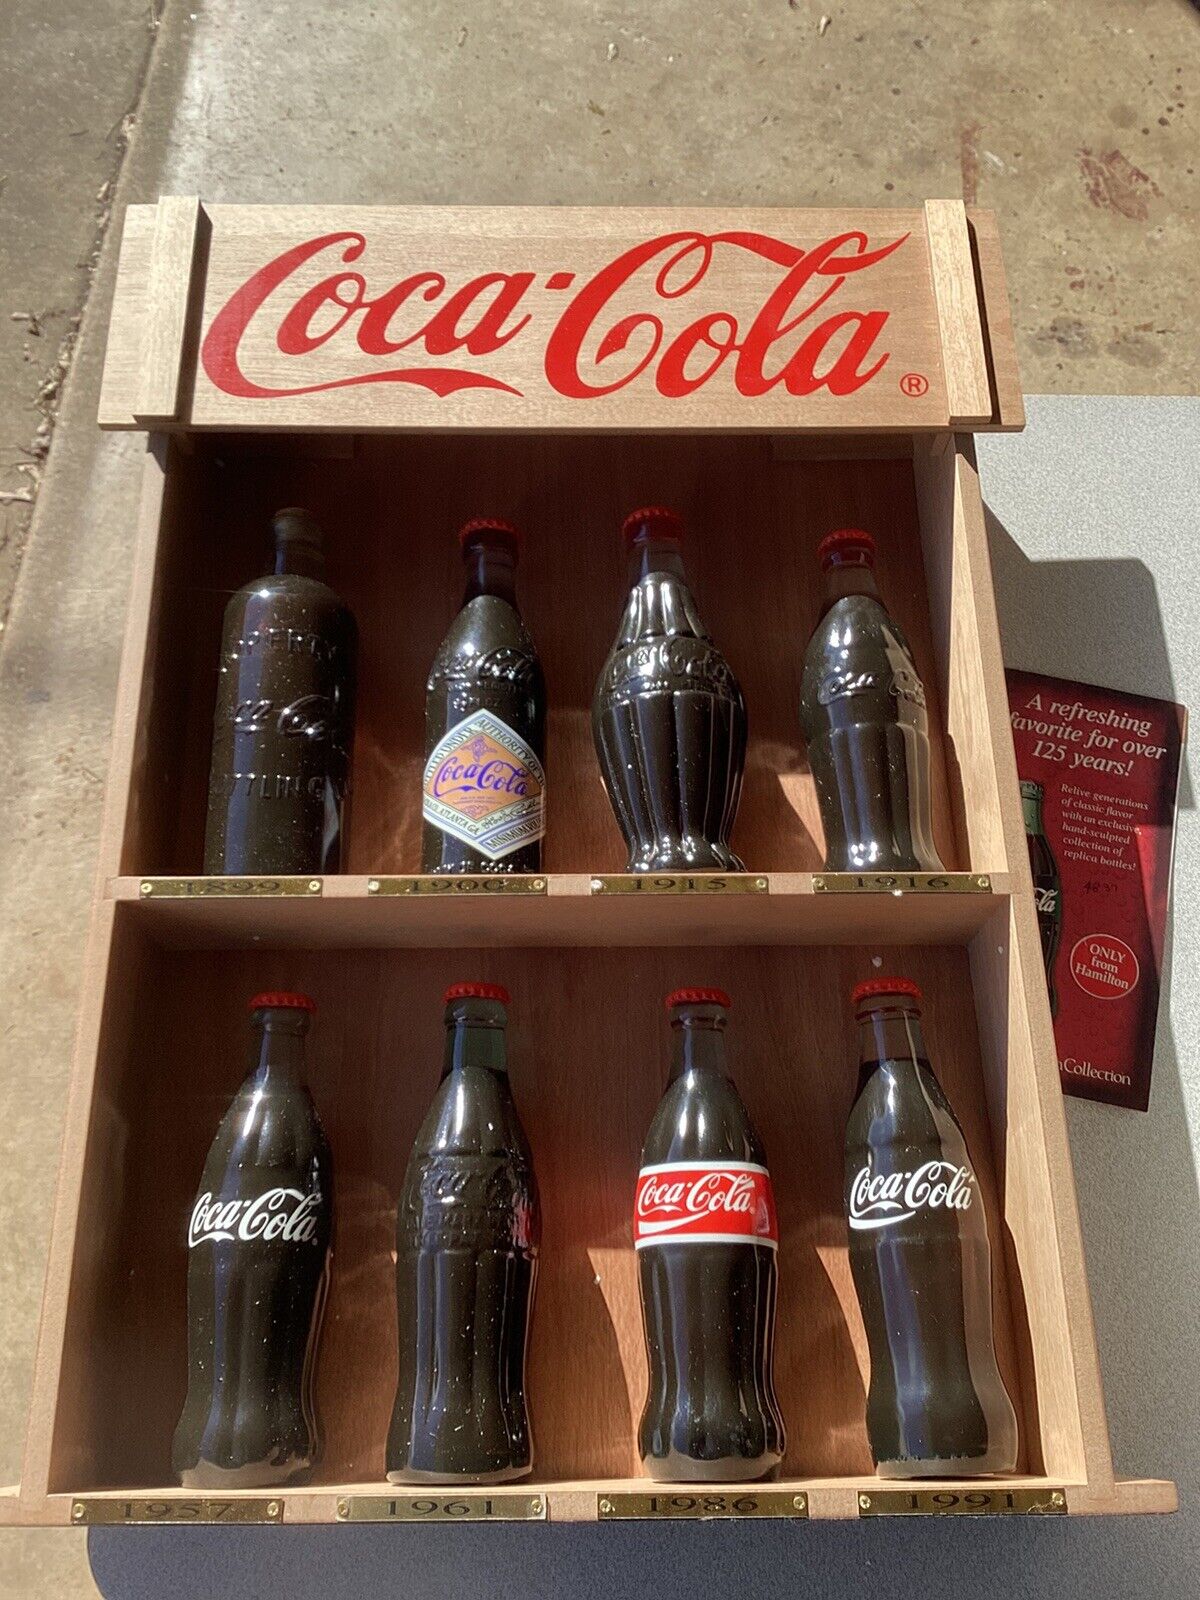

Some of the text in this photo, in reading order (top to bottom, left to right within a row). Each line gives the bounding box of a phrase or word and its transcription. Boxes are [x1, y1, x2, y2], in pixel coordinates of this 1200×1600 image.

[201, 231, 911, 398] Coca-Cola
[1025, 693, 1152, 738] A refreshing
[1083, 729, 1119, 748] for
[1123, 740, 1167, 760] over
[1031, 740, 1134, 776] 125 years!
[1061, 783, 1149, 810] Relive generations
[1061, 797, 1134, 819] of classic flavor
[1062, 811, 1083, 821] with
[1083, 816, 1096, 824] an
[1062, 821, 1131, 845] hand-sculpted
[1062, 837, 1124, 857] collection of
[1063, 849, 1137, 871] replica bottles!
[634, 878, 727, 890] 1915
[856, 876, 949, 888] 1916
[1089, 943, 1126, 964] ONLY
[1075, 962, 1129, 990] Hamilton
[1091, 956, 1118, 974] from
[638, 1173, 755, 1217] Coca-Cola
[850, 1161, 976, 1218] Coca-Cola
[188, 1188, 321, 1248] Coca-Cola
[122, 1503, 233, 1518] 1957
[387, 1500, 496, 1515] 1961
[648, 1496, 758, 1512] 1986
[908, 1493, 1015, 1509] 1991
